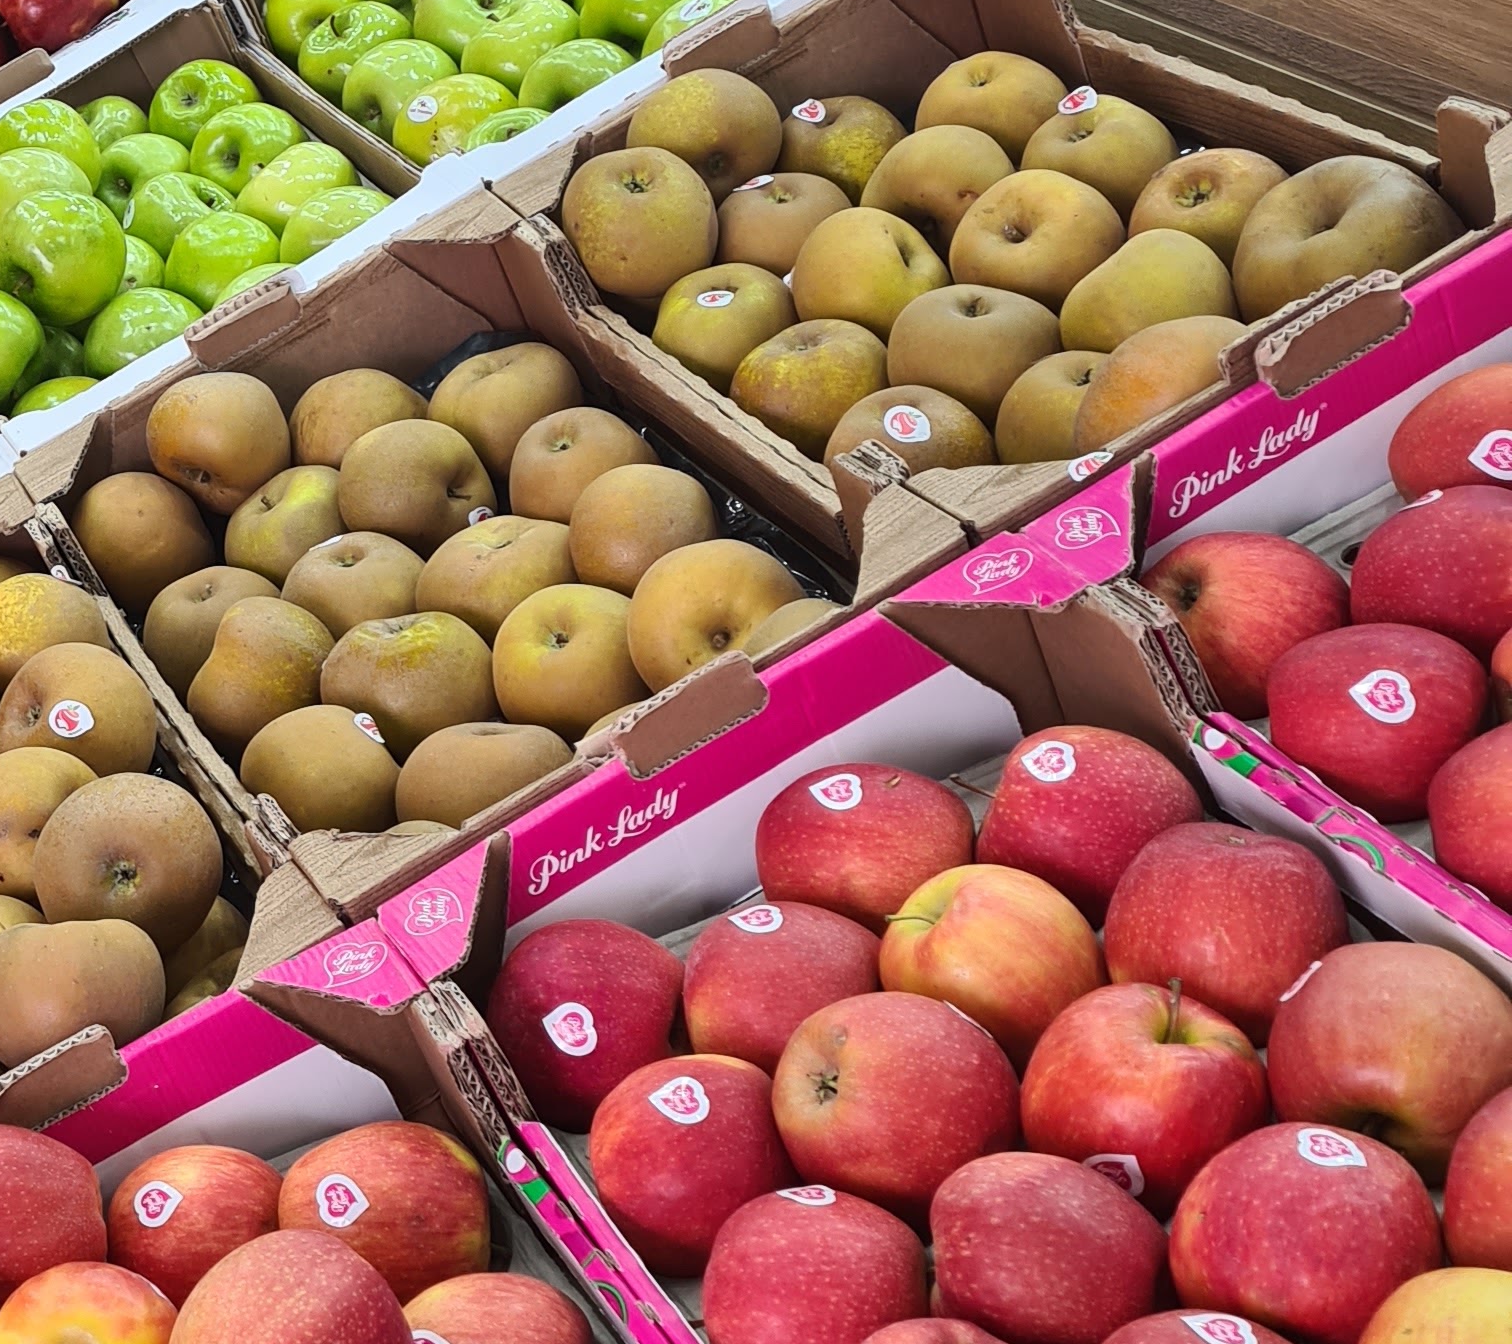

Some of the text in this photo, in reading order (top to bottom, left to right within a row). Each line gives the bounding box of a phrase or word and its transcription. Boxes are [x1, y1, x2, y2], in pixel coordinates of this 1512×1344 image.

[1169, 408, 1320, 518] Pink Lady
[972, 552, 1020, 577] Pink
[976, 565, 1020, 582] Lady
[528, 786, 679, 896] Pink Lady
[414, 898, 433, 928] Pink
[431, 894, 451, 926] Lady
[332, 960, 373, 976] Lady
[333, 947, 376, 966] Pink
